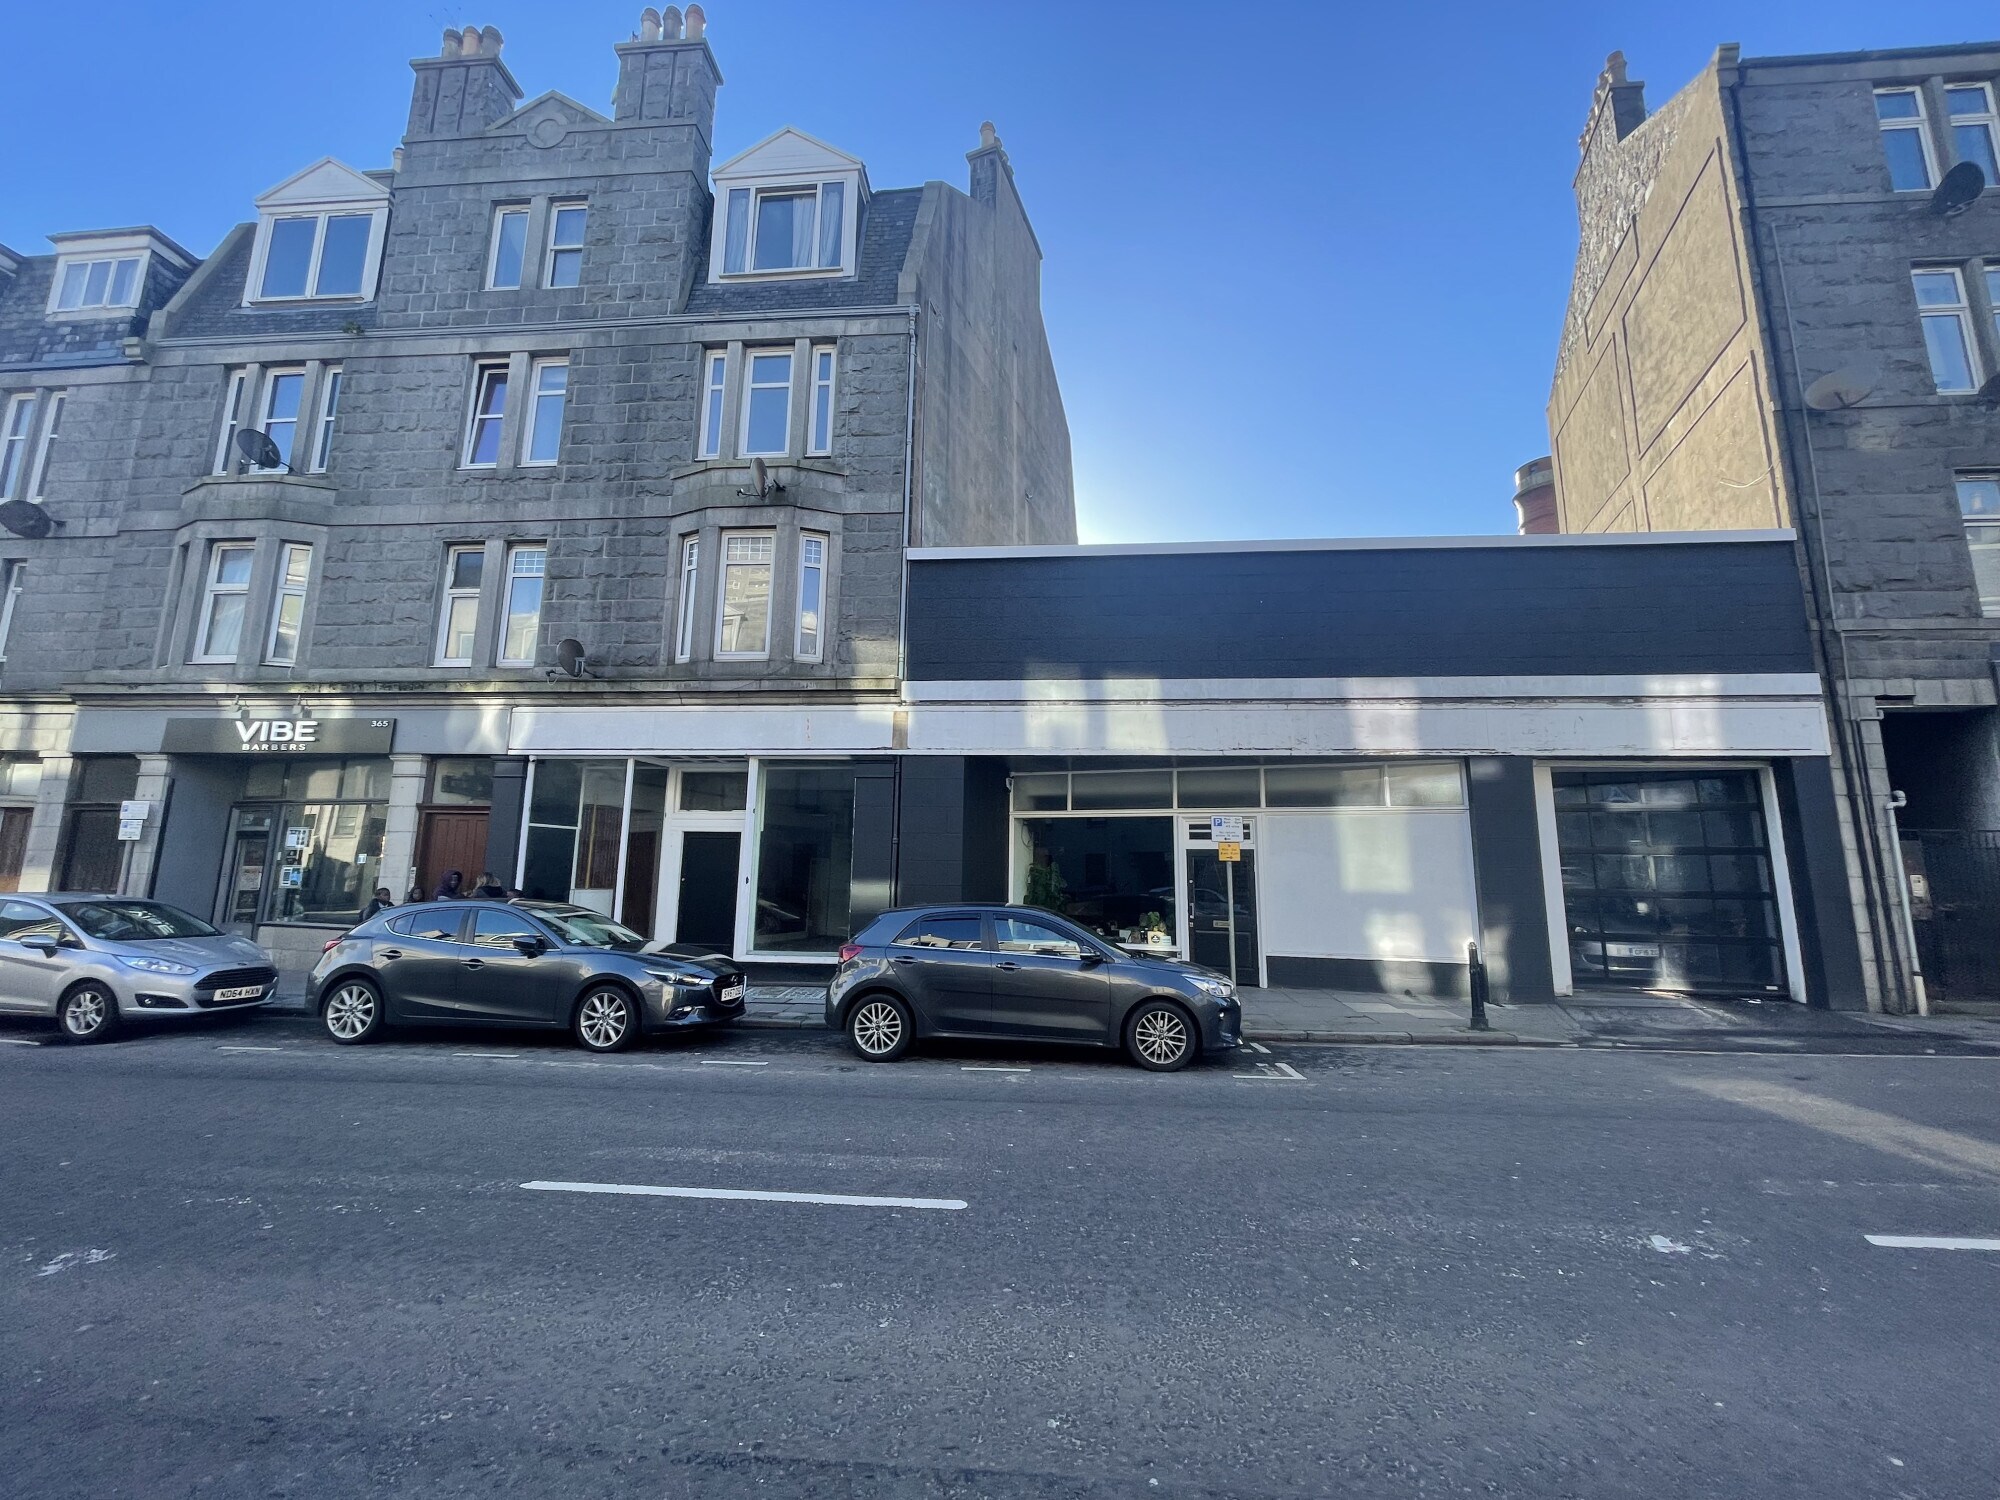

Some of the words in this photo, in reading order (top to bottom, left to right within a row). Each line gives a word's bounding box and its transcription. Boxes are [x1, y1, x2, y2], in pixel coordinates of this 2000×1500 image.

[370, 720, 389, 728] 365
[235, 720, 318, 743] VIBE
[241, 743, 307, 751] BARBERS
